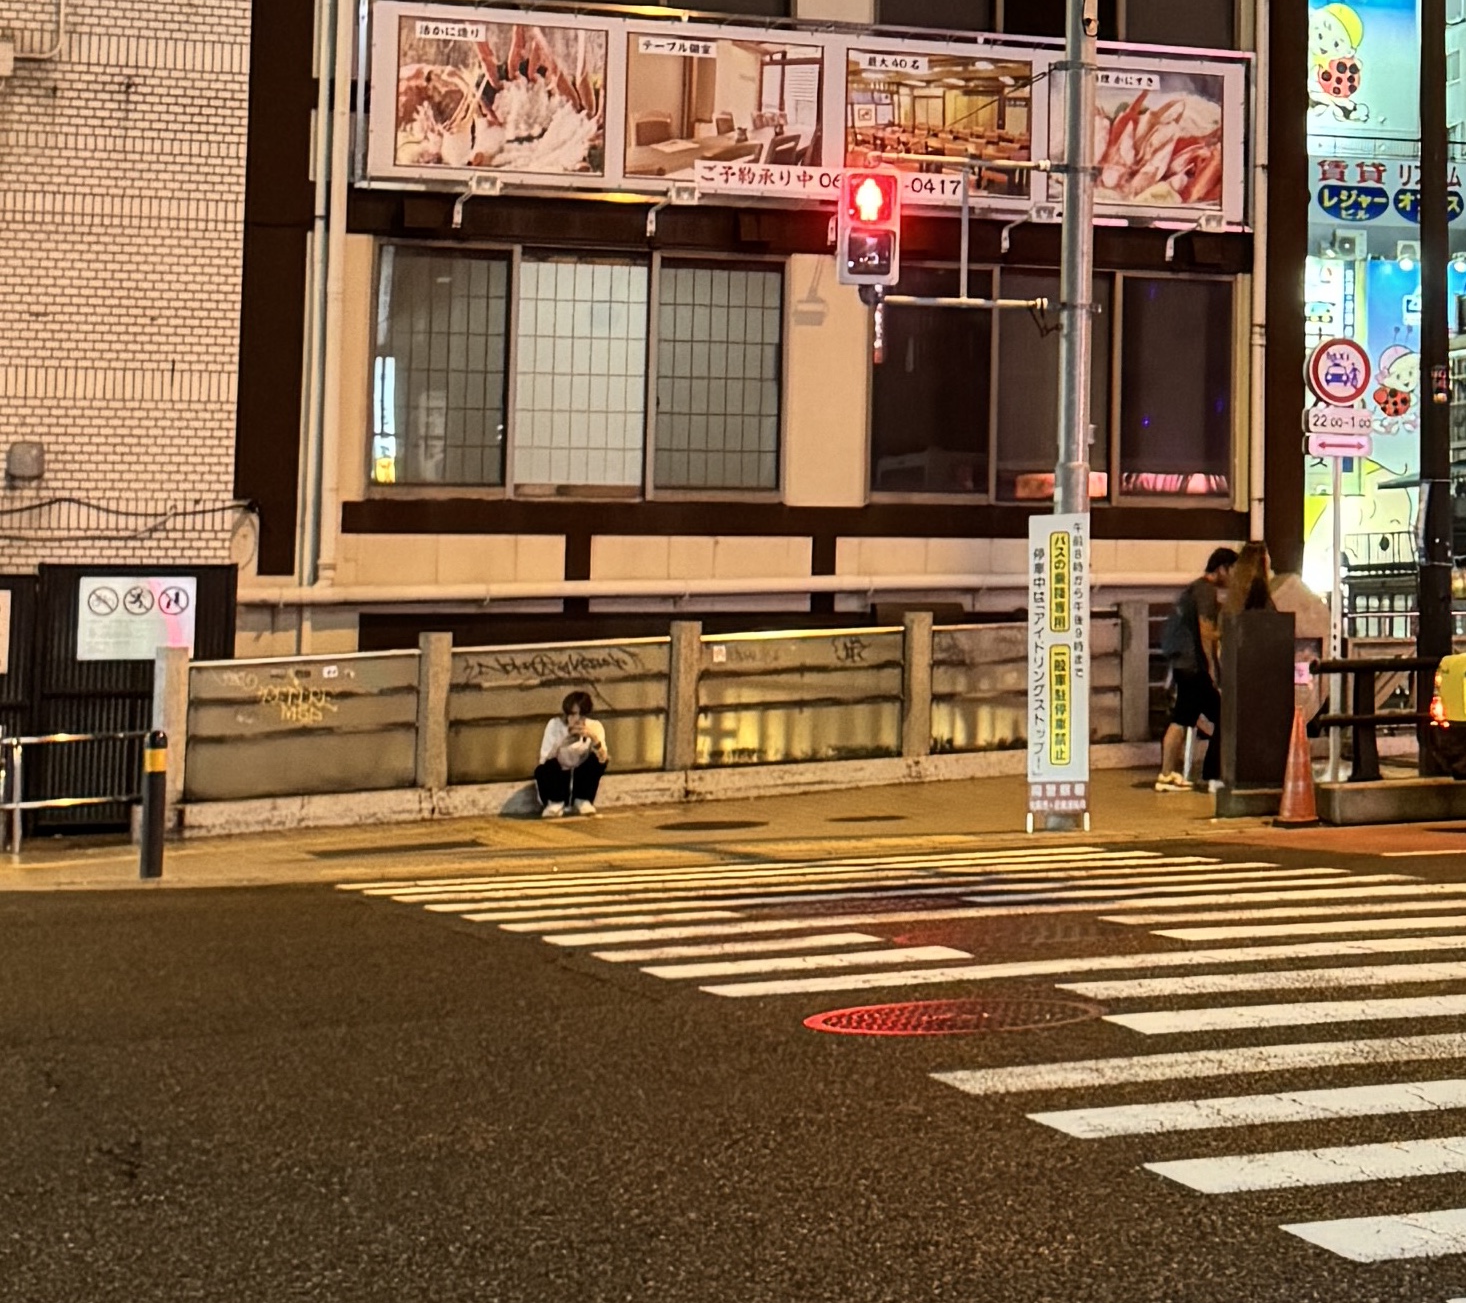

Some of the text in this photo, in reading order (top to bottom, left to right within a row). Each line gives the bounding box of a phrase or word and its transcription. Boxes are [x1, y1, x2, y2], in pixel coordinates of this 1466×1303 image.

[700, 163, 814, 187] ご予約承り中
[1317, 160, 1387, 185] 賃貸
[1323, 189, 1387, 208] レジャー
[1341, 209, 1370, 220] ビル
